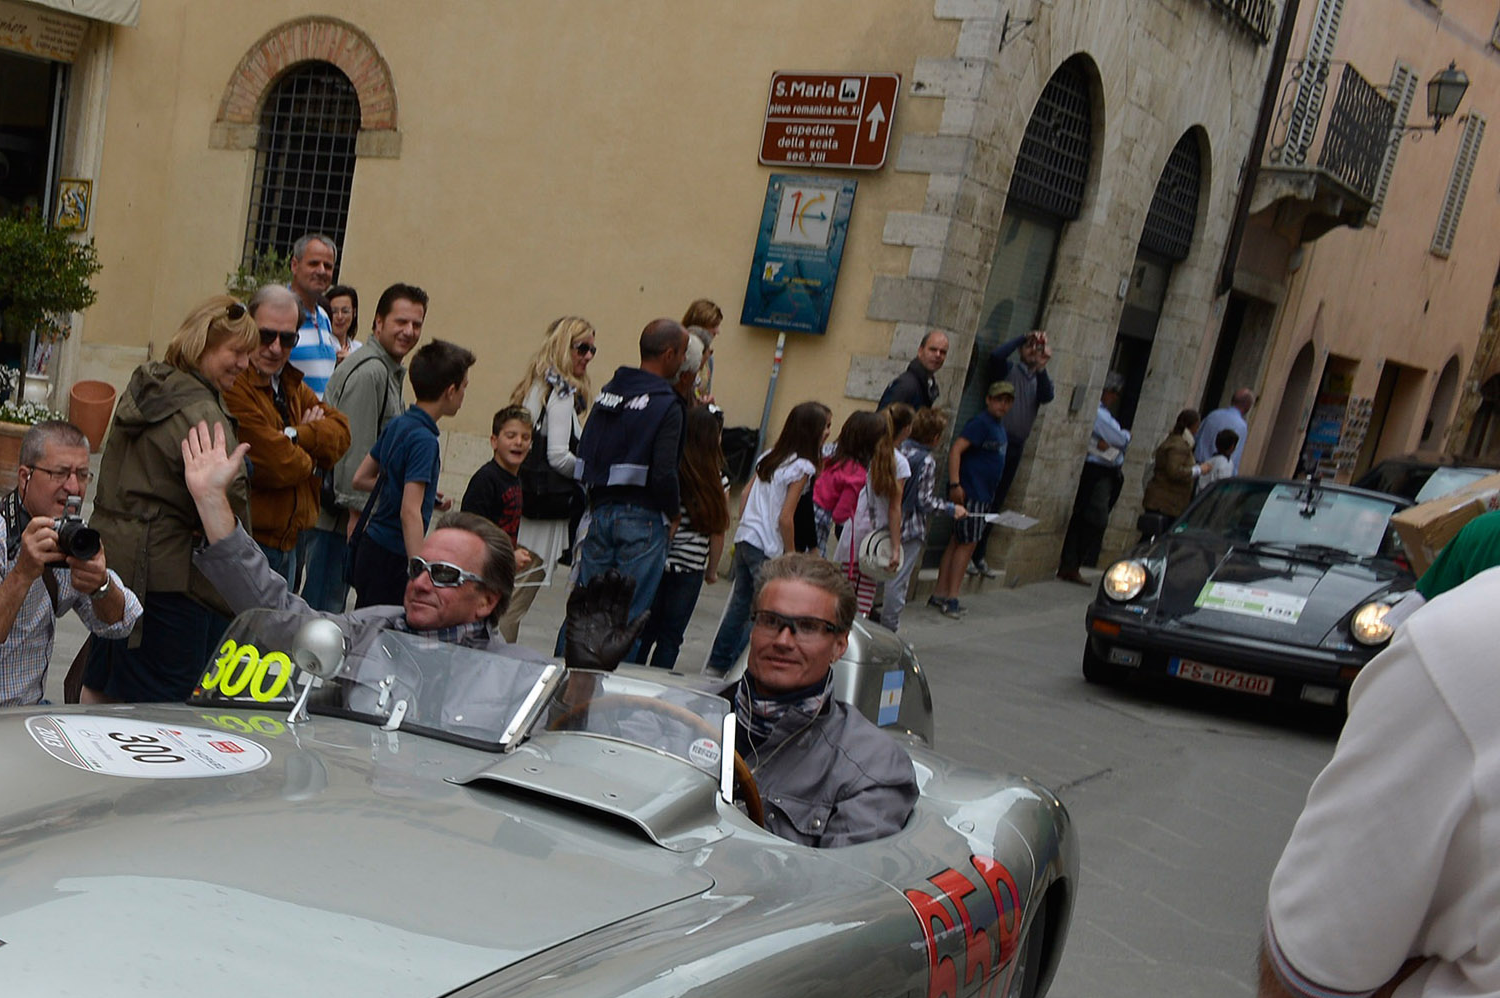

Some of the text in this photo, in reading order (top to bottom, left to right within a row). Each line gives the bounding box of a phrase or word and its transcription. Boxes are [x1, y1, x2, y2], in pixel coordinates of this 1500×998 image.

[790, 81, 835, 98] Maria
[793, 104, 832, 115] romanica
[785, 125, 836, 137] ospedale
[777, 136, 839, 150] della scala
[786, 151, 827, 163] sec. XIII
[201, 638, 291, 703] 300
[1180, 661, 1203, 679] FS
[34, 725, 66, 748] 2013
[108, 731, 186, 764] 300
